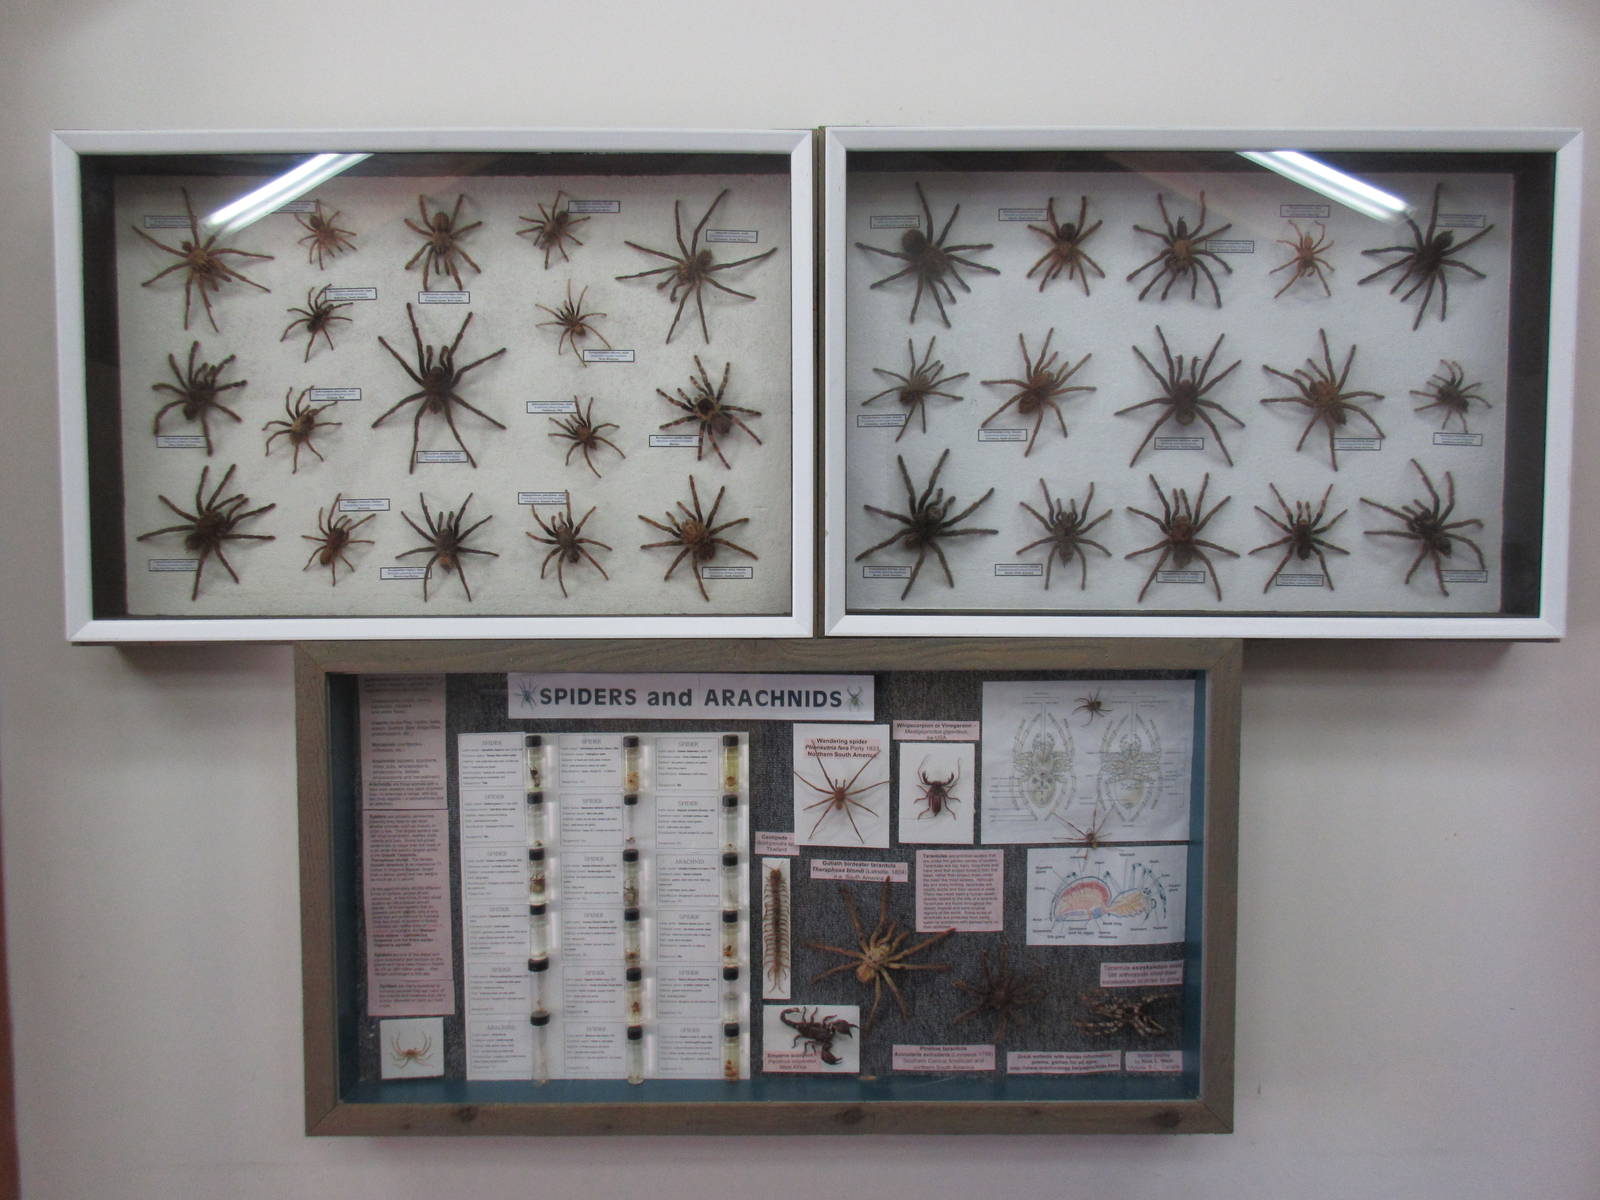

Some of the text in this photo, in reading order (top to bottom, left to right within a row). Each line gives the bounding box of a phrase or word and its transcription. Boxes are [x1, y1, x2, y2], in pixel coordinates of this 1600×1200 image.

[540, 687, 842, 707] SPIDERS and ARACHNIDS
